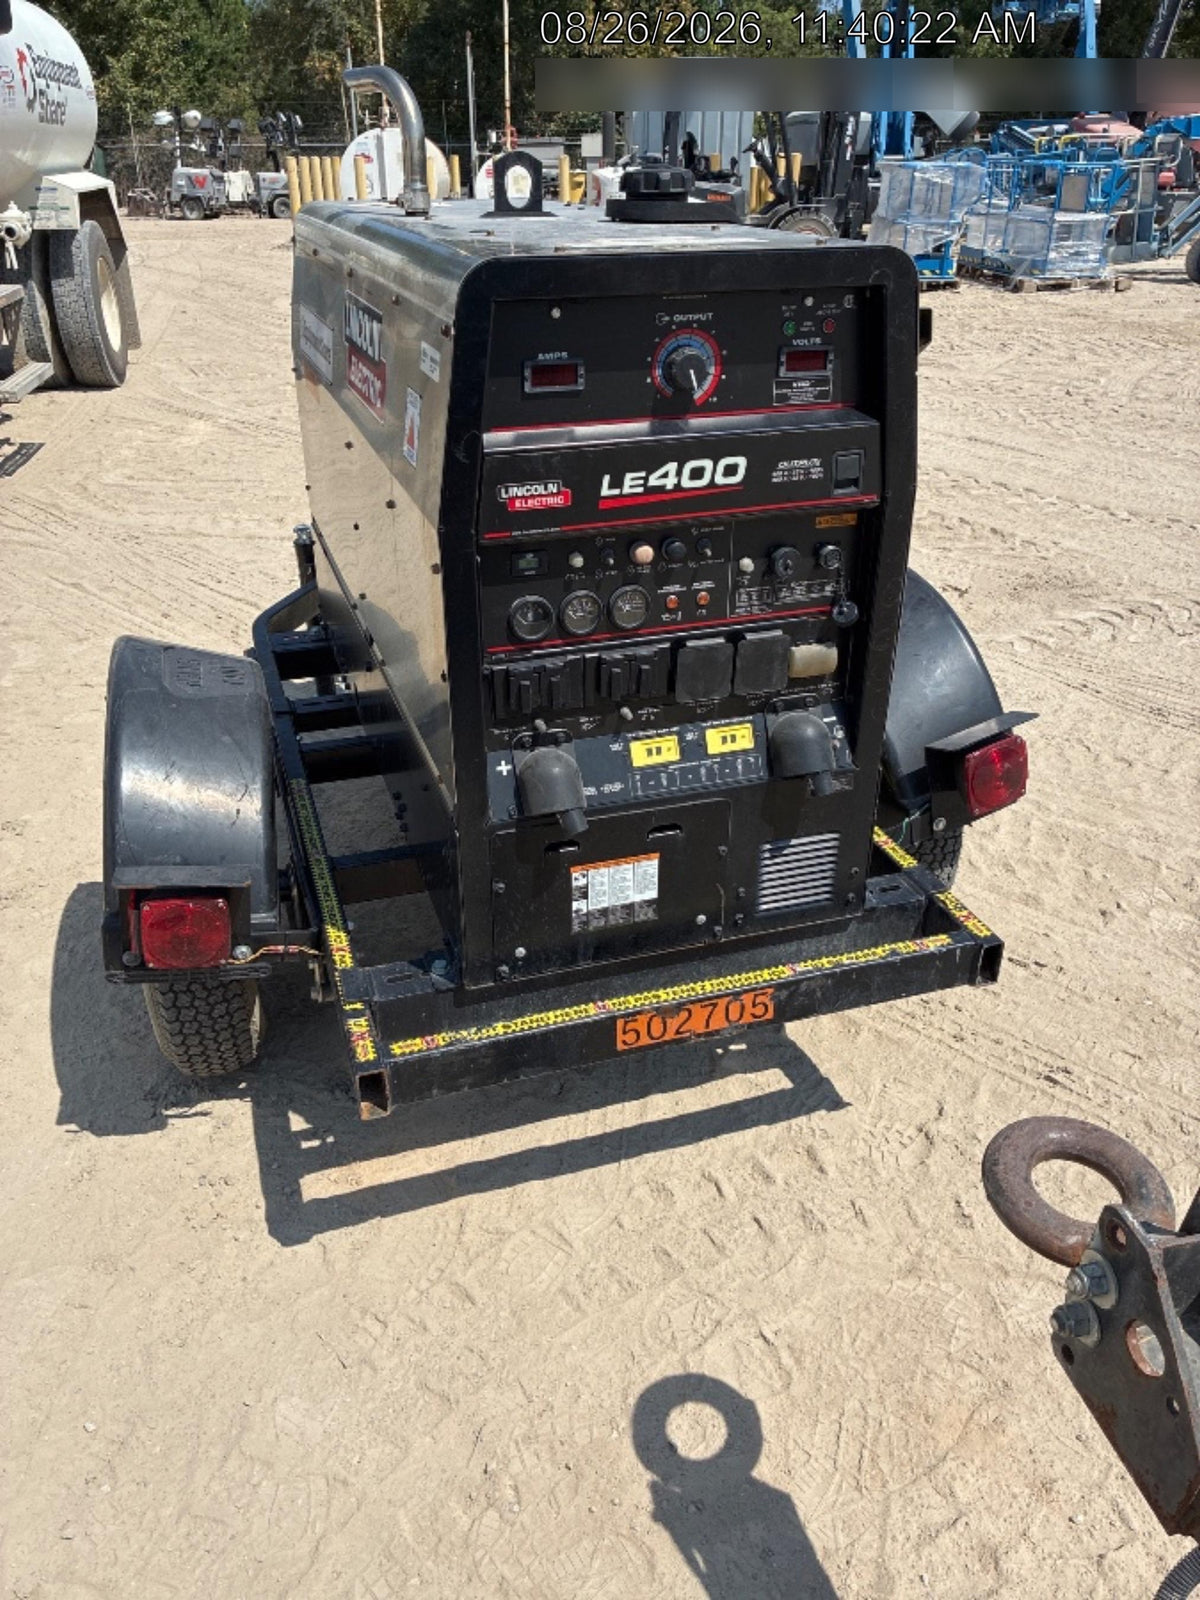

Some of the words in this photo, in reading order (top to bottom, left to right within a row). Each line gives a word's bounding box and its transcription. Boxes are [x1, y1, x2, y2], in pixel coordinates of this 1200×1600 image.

[673, 312, 714, 321] OUTPUT
[792, 337, 822, 346] VOLTS
[537, 351, 568, 361] AMPS
[600, 456, 748, 497] LE400
[500, 482, 558, 499] LINCOLN
[514, 495, 565, 508] ELECTRIC
[620, 991, 770, 1047] 502705
